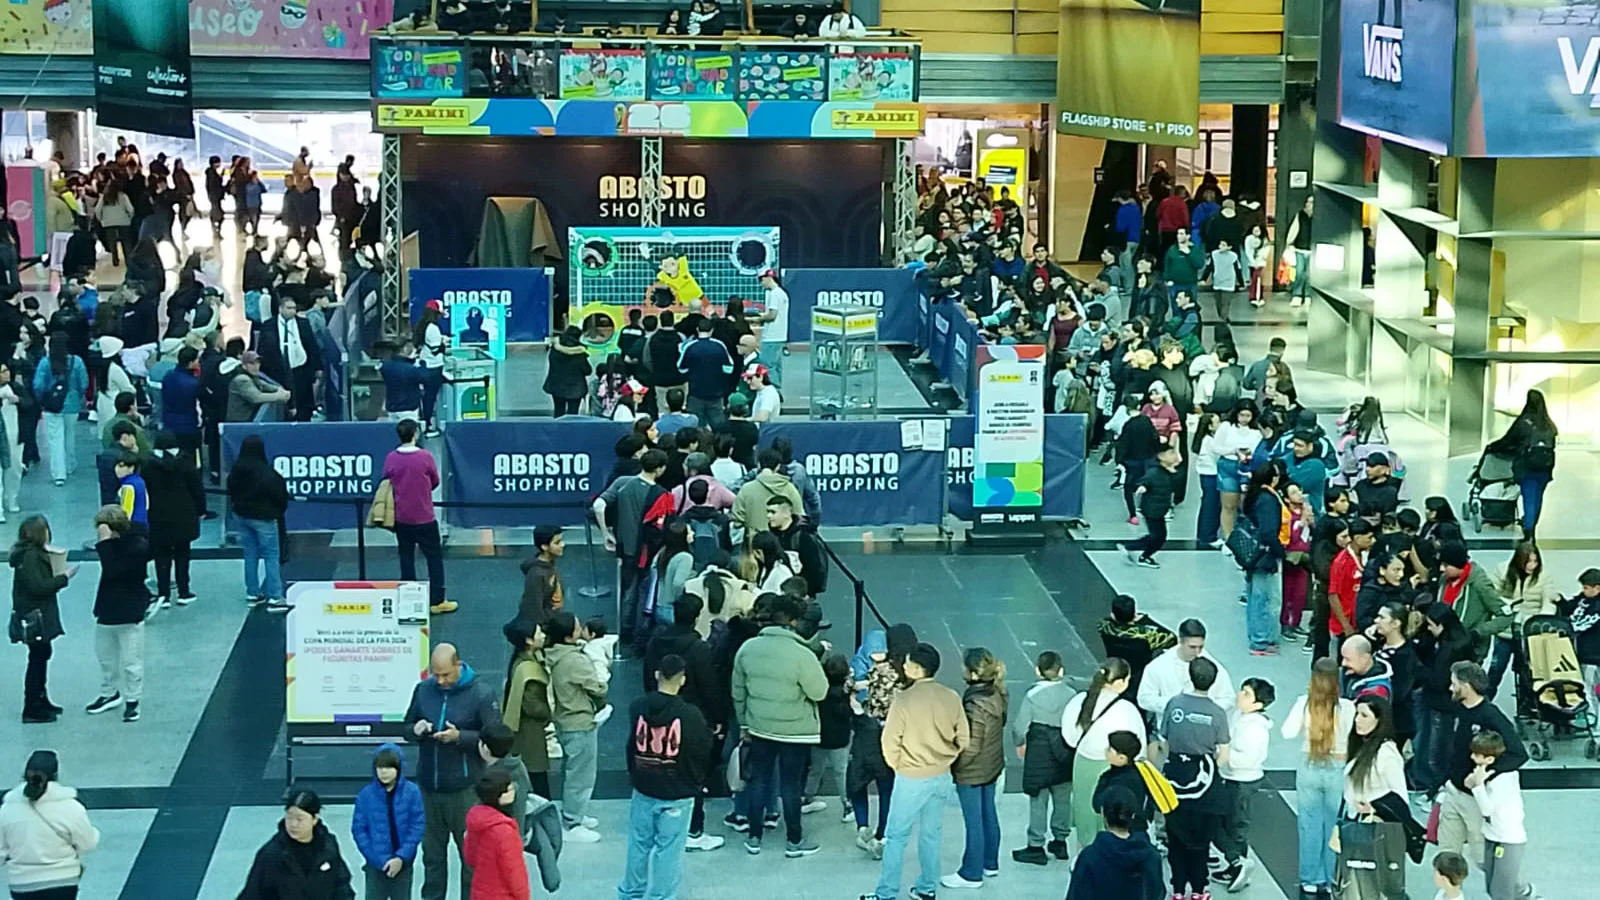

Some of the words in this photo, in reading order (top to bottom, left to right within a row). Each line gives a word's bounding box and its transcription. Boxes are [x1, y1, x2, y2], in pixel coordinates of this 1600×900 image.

[1362, 22, 1404, 83] VANS
[404, 108, 465, 119] PANINI
[855, 111, 916, 123] PANINI
[1061, 111, 1111, 127] FLAGSHIP
[1111, 117, 1147, 132] STORE
[1166, 123, 1194, 136] PISO
[443, 290, 512, 306] ABASTO
[817, 291, 884, 306] ABASTO
[273, 455, 373, 478] ABASTO
[493, 453, 591, 477] ABASTO
[806, 452, 899, 476] ABASTO
[286, 479, 373, 494] HOPPING
[493, 477, 591, 492] SHOPPING
[816, 476, 899, 491] HOPPING
